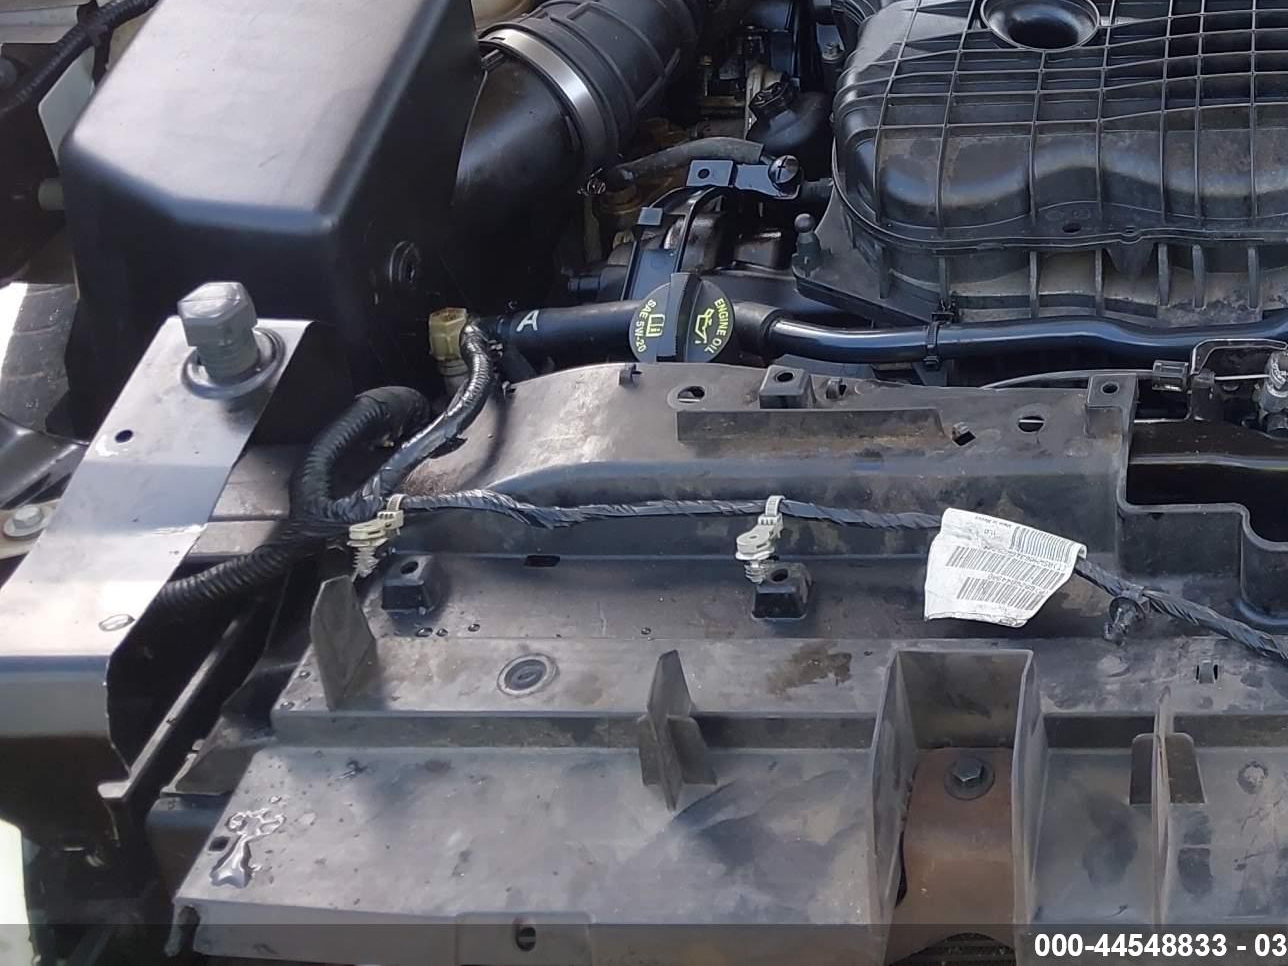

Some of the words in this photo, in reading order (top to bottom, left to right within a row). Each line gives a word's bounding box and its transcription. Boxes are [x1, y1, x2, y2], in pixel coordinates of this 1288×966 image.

[639, 299, 657, 319] SAE
[713, 297, 729, 336] ENGINE
[634, 322, 647, 353] 5W-20
[704, 337, 723, 354] OIL
